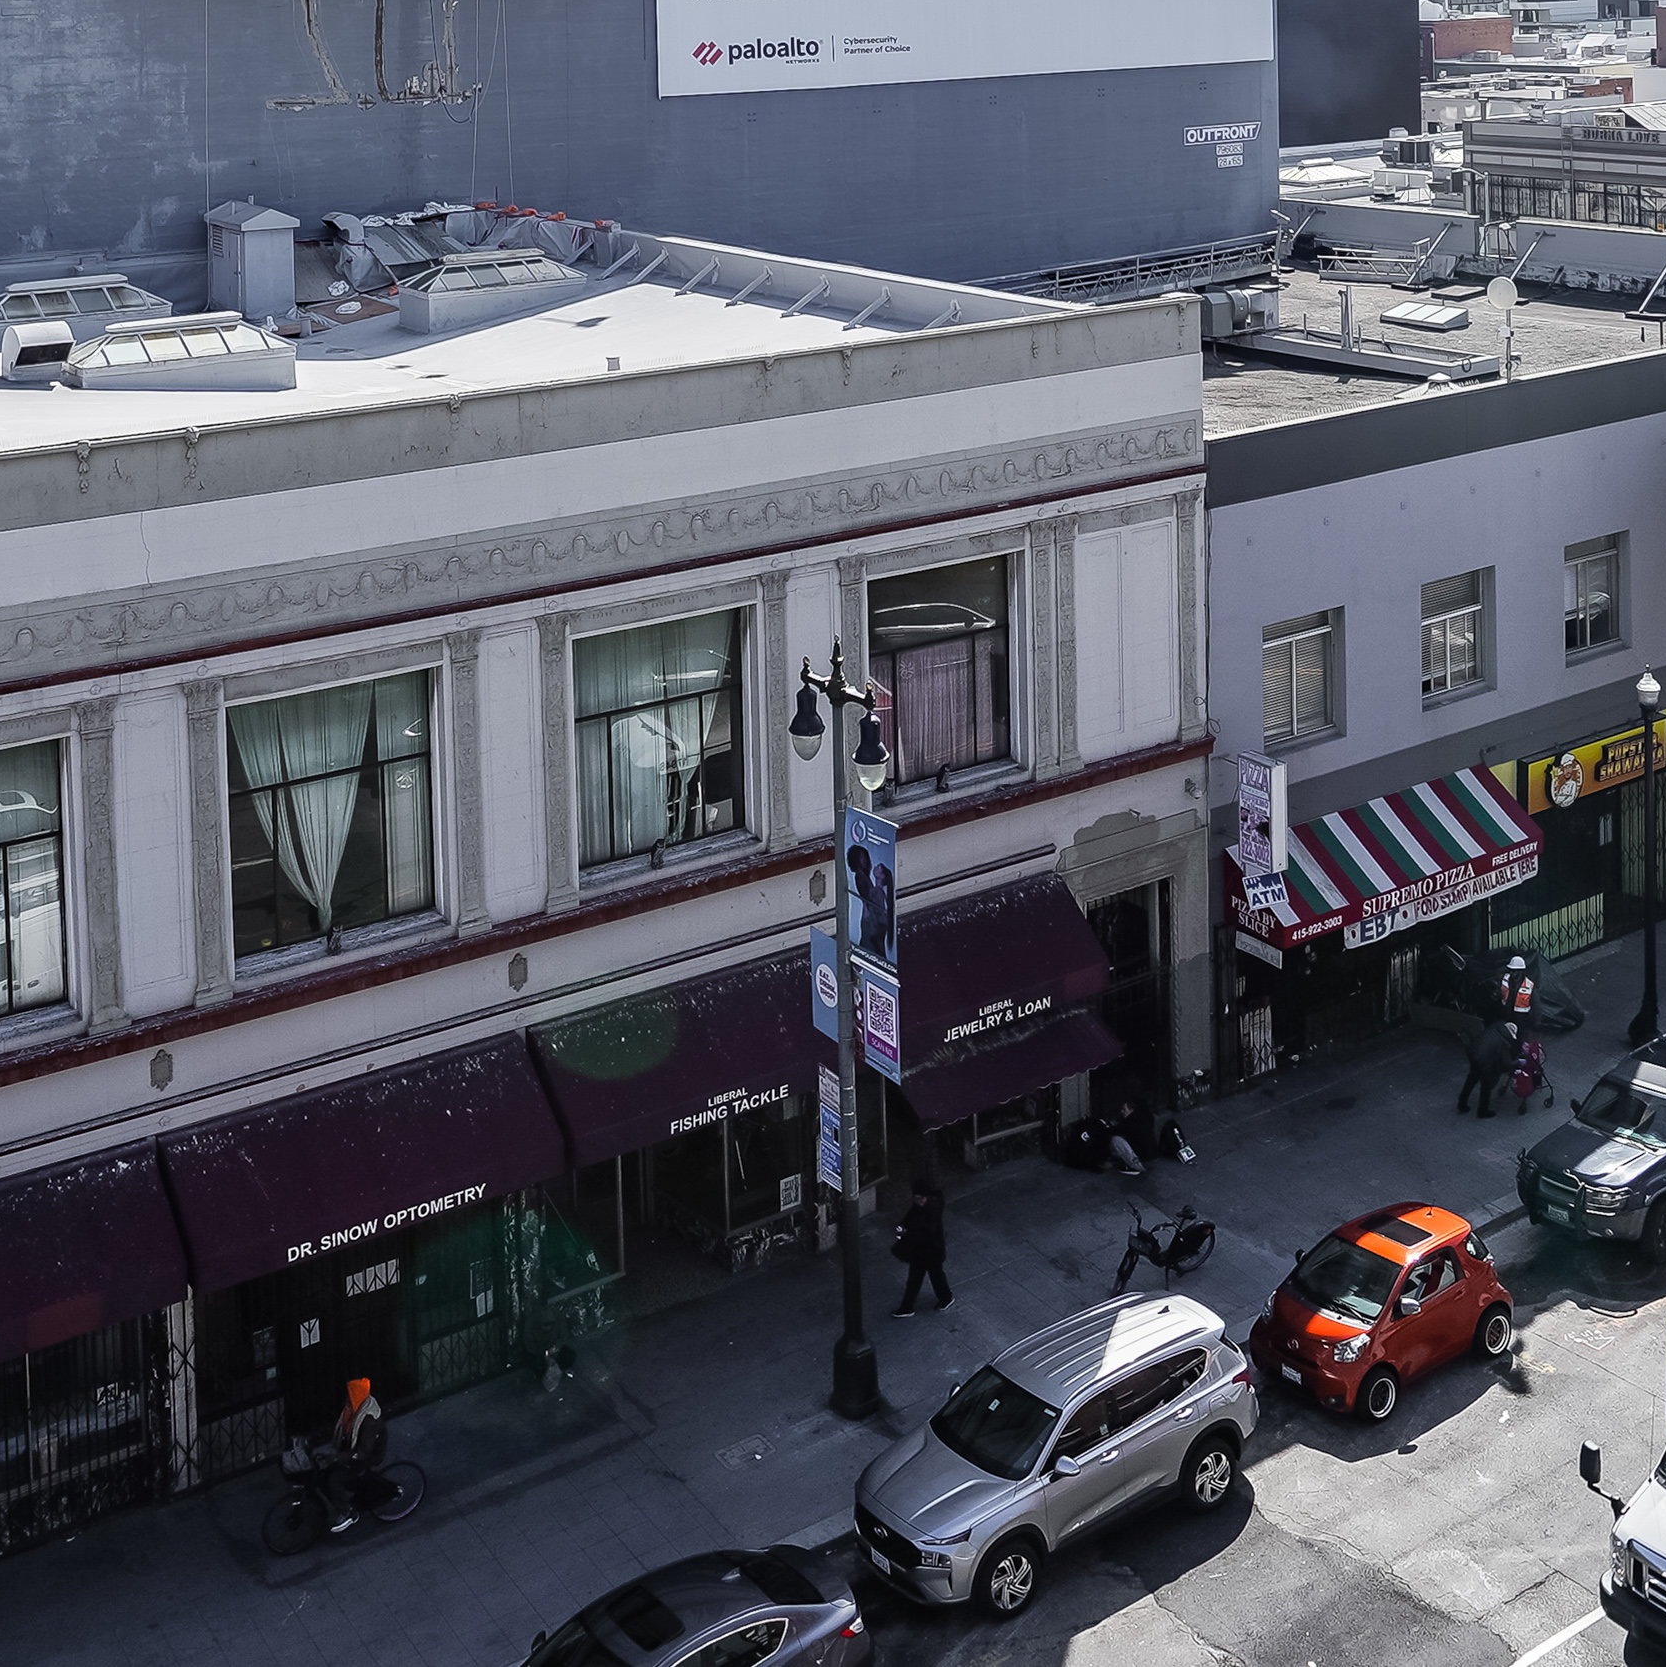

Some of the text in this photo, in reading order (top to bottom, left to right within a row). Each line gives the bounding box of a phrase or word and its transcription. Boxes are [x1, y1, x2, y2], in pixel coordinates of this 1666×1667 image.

[728, 37, 820, 65] paloalto
[843, 35, 898, 46] Cybersecurity
[844, 44, 911, 55] Partner of Choice
[1187, 125, 1256, 142] OUTFRONT
[1581, 129, 1660, 143] BURMA LOVE
[1240, 759, 1270, 794] PIZZA
[1492, 841, 1538, 867] FREE DELIVERY
[1252, 885, 1286, 907] ATM
[1362, 863, 1476, 918] SUPREMO PIZZA
[1440, 886, 1469, 910] STAMP
[1471, 866, 1517, 897] AVAILABLE
[1238, 912, 1269, 938] SLICE
[1261, 911, 1277, 930] BY
[1360, 909, 1400, 942] EBT
[943, 996, 1052, 1043] JEWELRY & LOAN
[978, 998, 1014, 1017] LIBERAL
[670, 1104, 729, 1135] FISHING
[732, 1084, 790, 1115] TACKLE
[707, 1086, 748, 1108] LIBERAL
[287, 1183, 487, 1263] DR. SINOW OPTOMETRY
